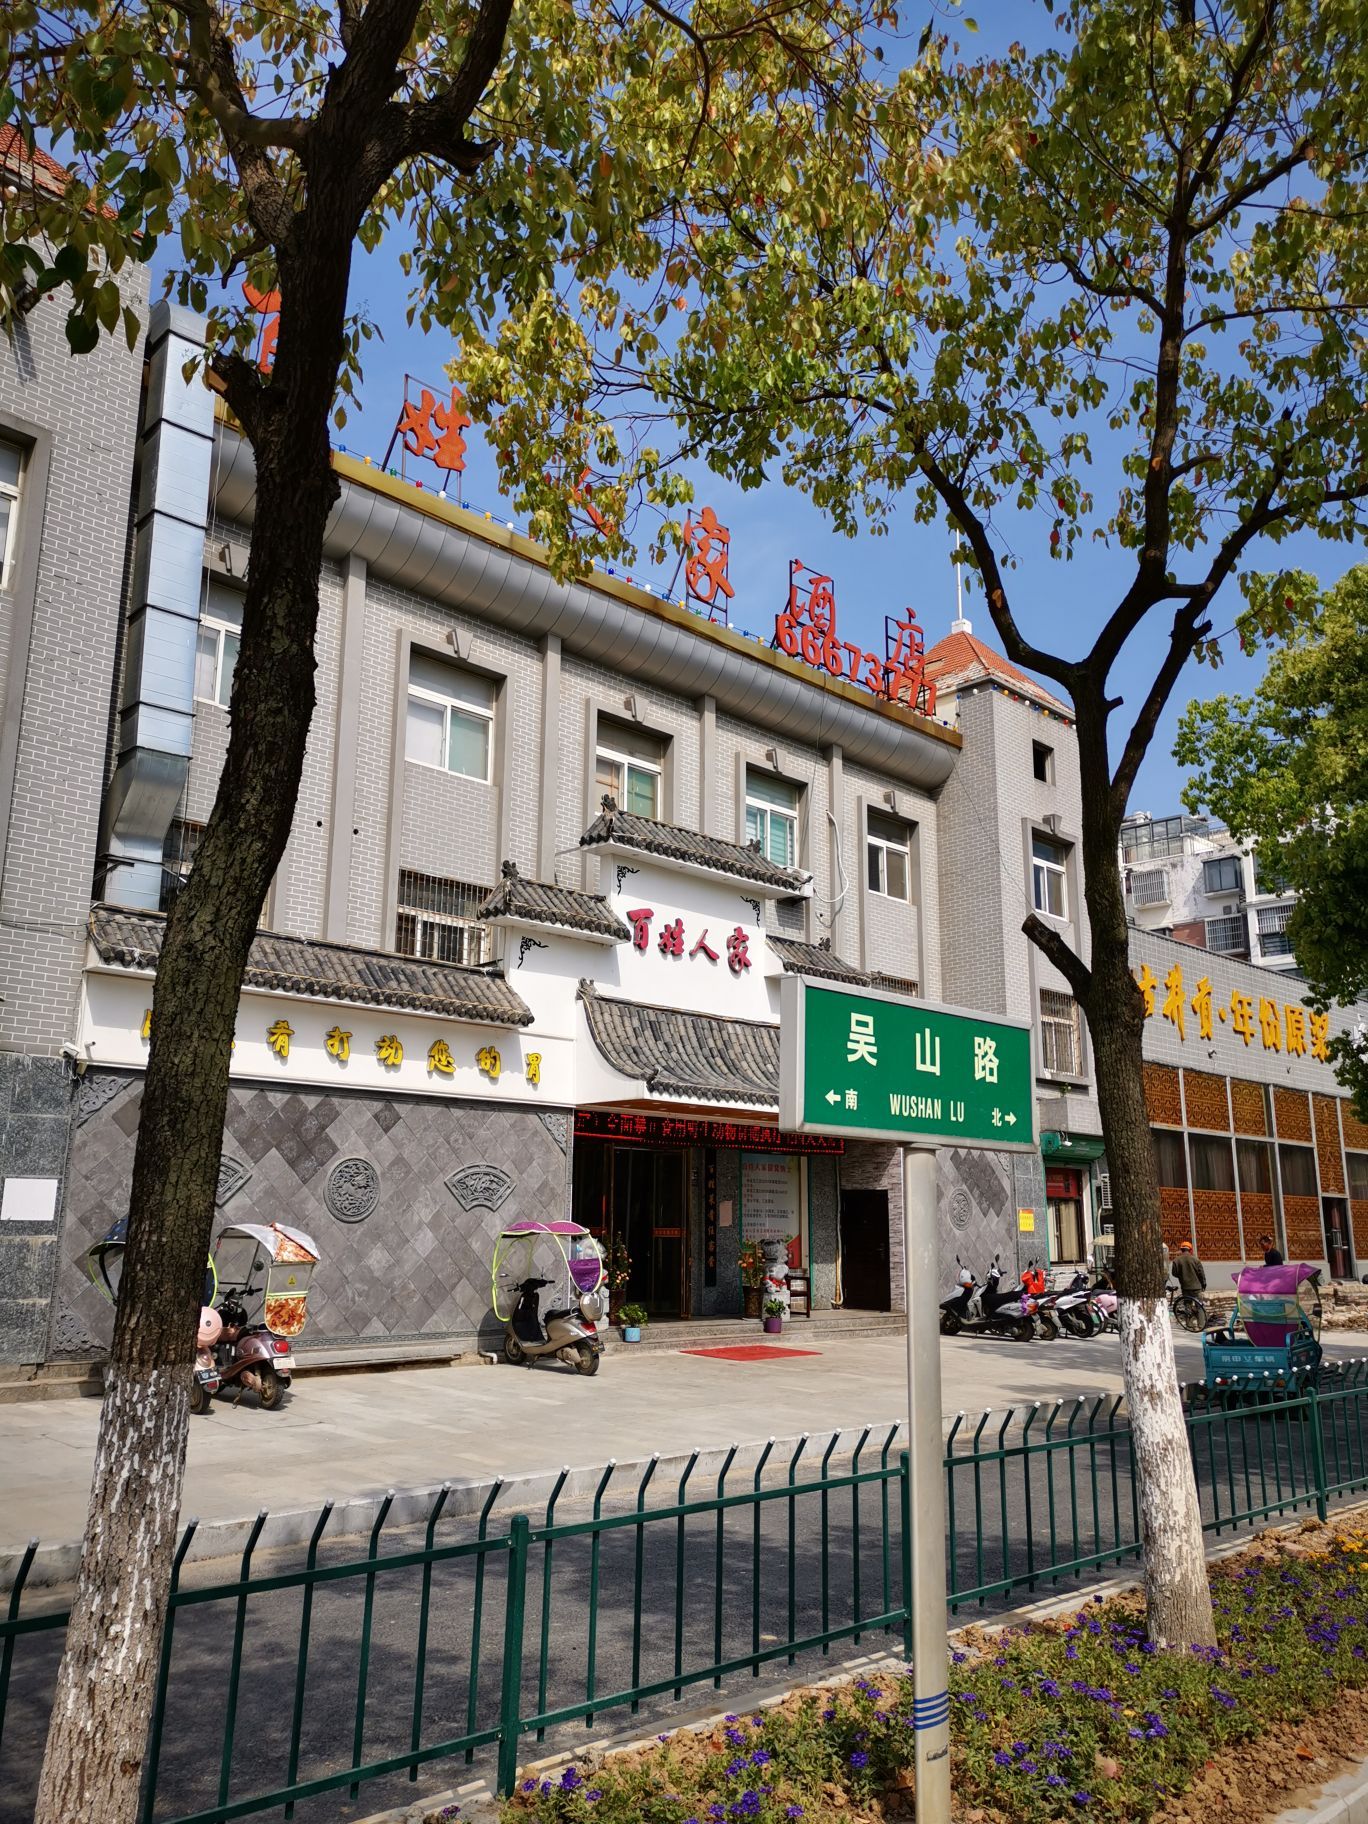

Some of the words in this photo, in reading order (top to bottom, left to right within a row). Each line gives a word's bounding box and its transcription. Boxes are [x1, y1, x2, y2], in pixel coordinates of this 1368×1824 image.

[776, 612, 937, 717] 66673777
[627, 908, 752, 973] 百姓人家
[847, 1012, 1000, 1084] 吴山路
[845, 1088, 858, 1111] 南
[889, 1093, 942, 1120] WUSHAN
[950, 1100, 965, 1122] LU
[991, 1107, 1003, 1127] 北
